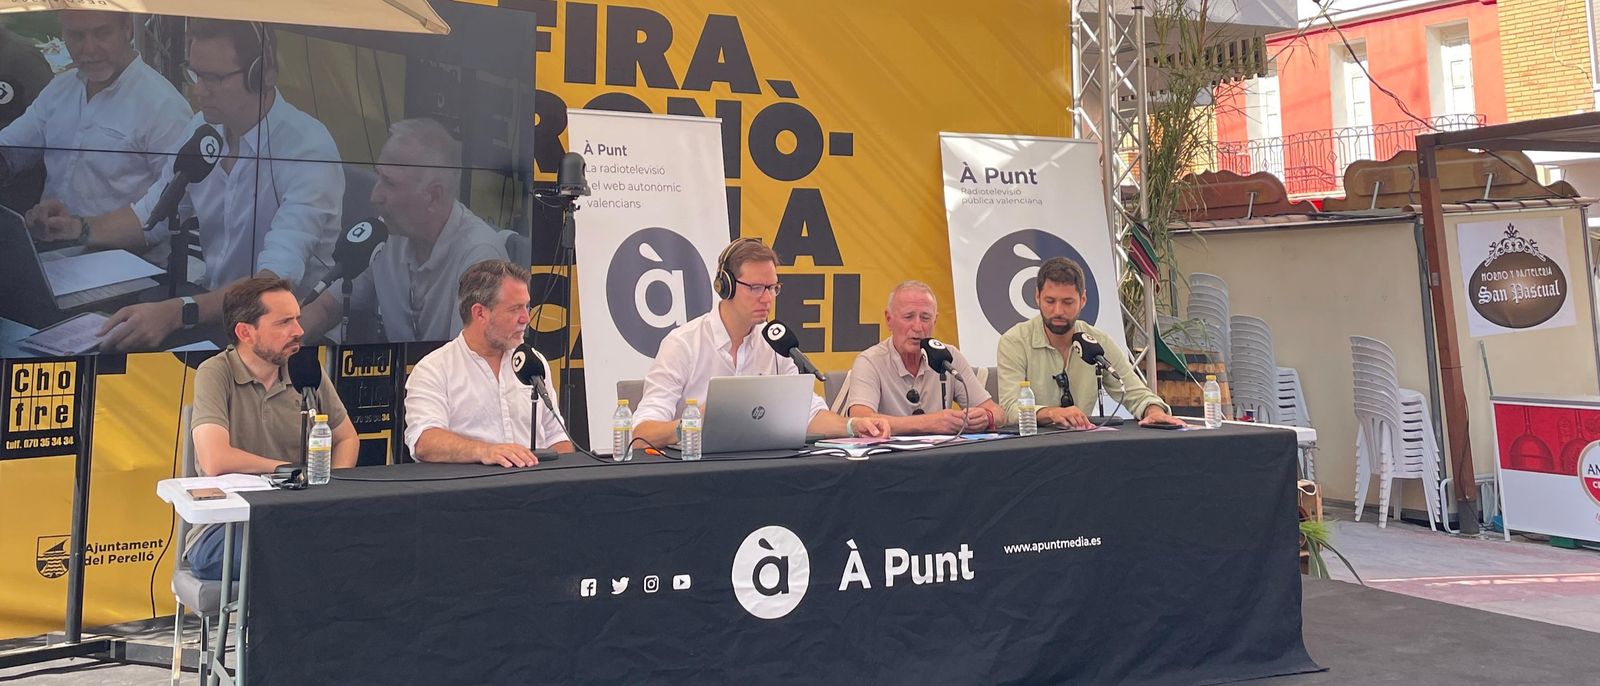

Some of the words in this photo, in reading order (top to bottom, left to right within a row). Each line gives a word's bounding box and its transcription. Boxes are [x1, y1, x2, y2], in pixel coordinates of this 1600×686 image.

[583, 140, 594, 155] À
[597, 143, 628, 156] Punt
[585, 163, 597, 173] La
[599, 163, 666, 175] radiotelevisió
[960, 161, 977, 184] À
[984, 167, 1038, 185] Punt
[591, 180, 601, 190] el
[603, 181, 626, 191] web
[587, 198, 641, 209] valencians
[1478, 285, 1508, 304] San
[1510, 279, 1561, 304] Pascual
[85, 539, 163, 554] Ajuntament
[1003, 536, 1102, 554] www.apuntmedia.es
[84, 555, 104, 566] del
[108, 551, 154, 564] Perelló
[838, 538, 872, 591] À
[884, 543, 975, 587] Punt
